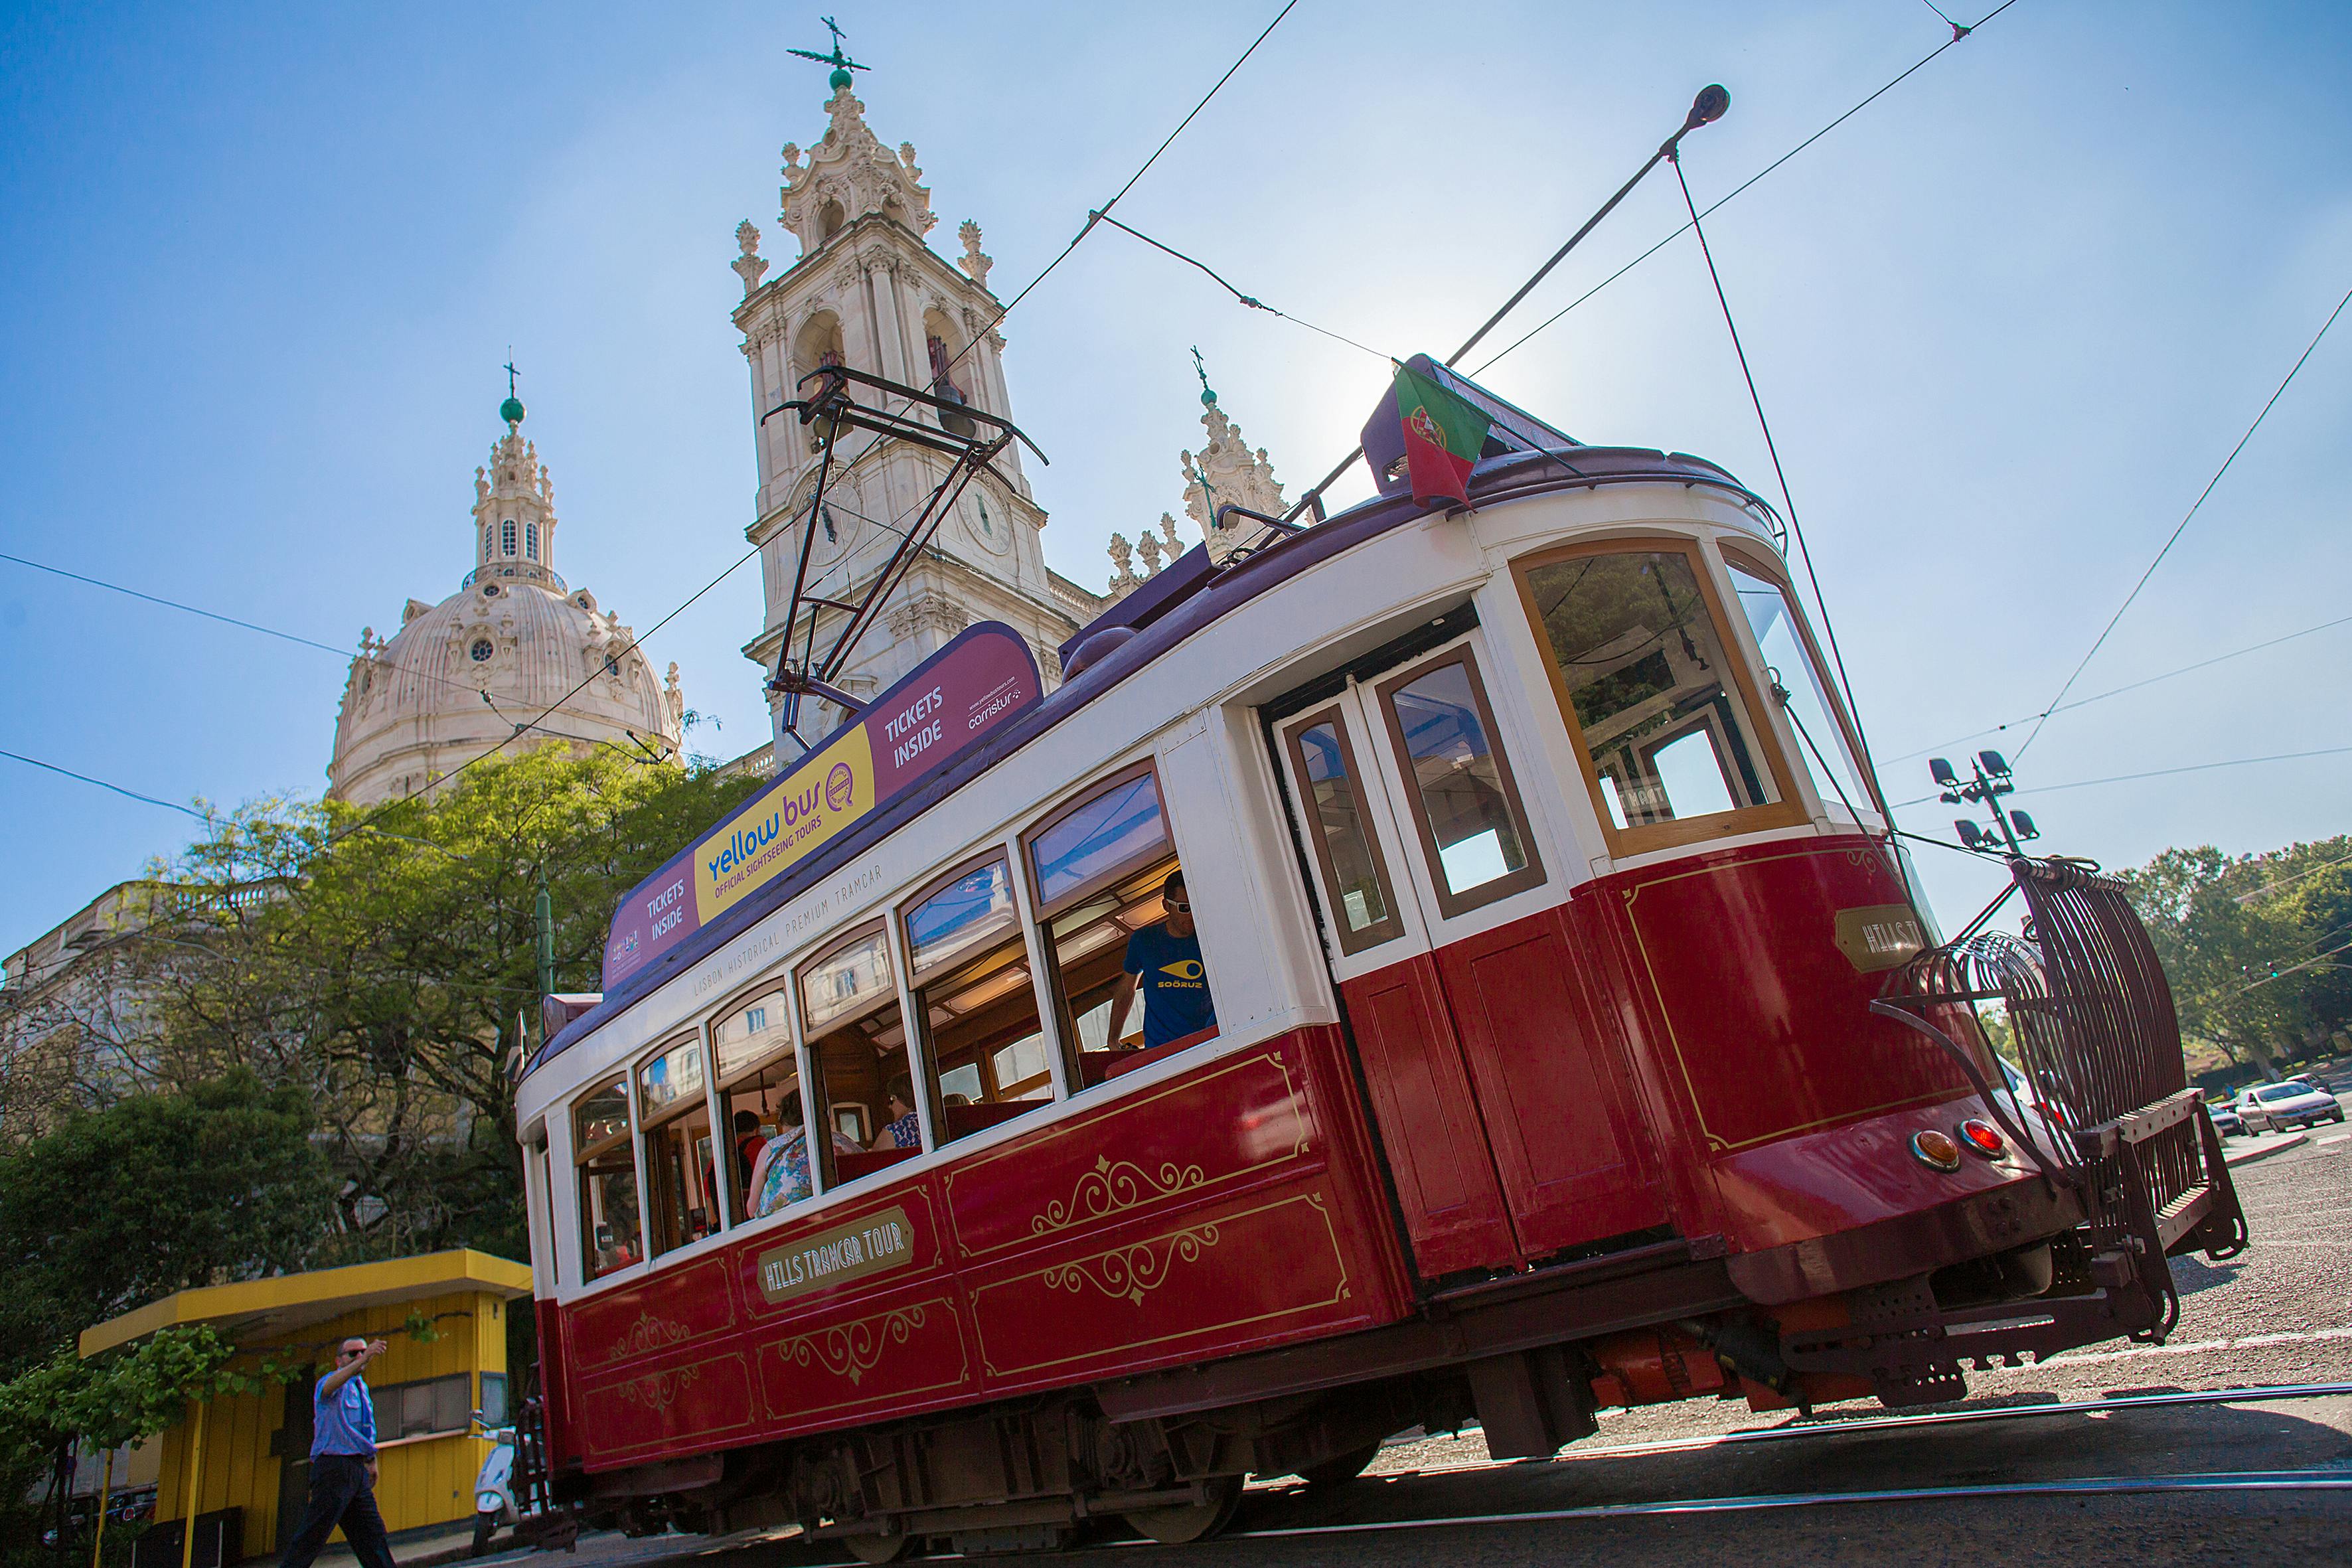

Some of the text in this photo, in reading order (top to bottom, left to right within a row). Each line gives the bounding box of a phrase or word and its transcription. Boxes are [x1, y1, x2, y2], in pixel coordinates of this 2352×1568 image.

[885, 686, 943, 742] TICKETS
[969, 692, 1012, 730] carristur
[894, 718, 942, 769] INSIDE
[709, 781, 821, 882] yellow bus
[715, 815, 822, 899] OFFICIAL SIGHTSEEING TOURS
[647, 878, 684, 918] TICKETS
[653, 905, 682, 941] INSIDE
[694, 865, 882, 996] LISBON HISTORICAL PREMIUM TRAMCAR
[1862, 921, 1911, 953] HILLS
[765, 1221, 904, 1291] HILLS TRAMCAR TOUR
